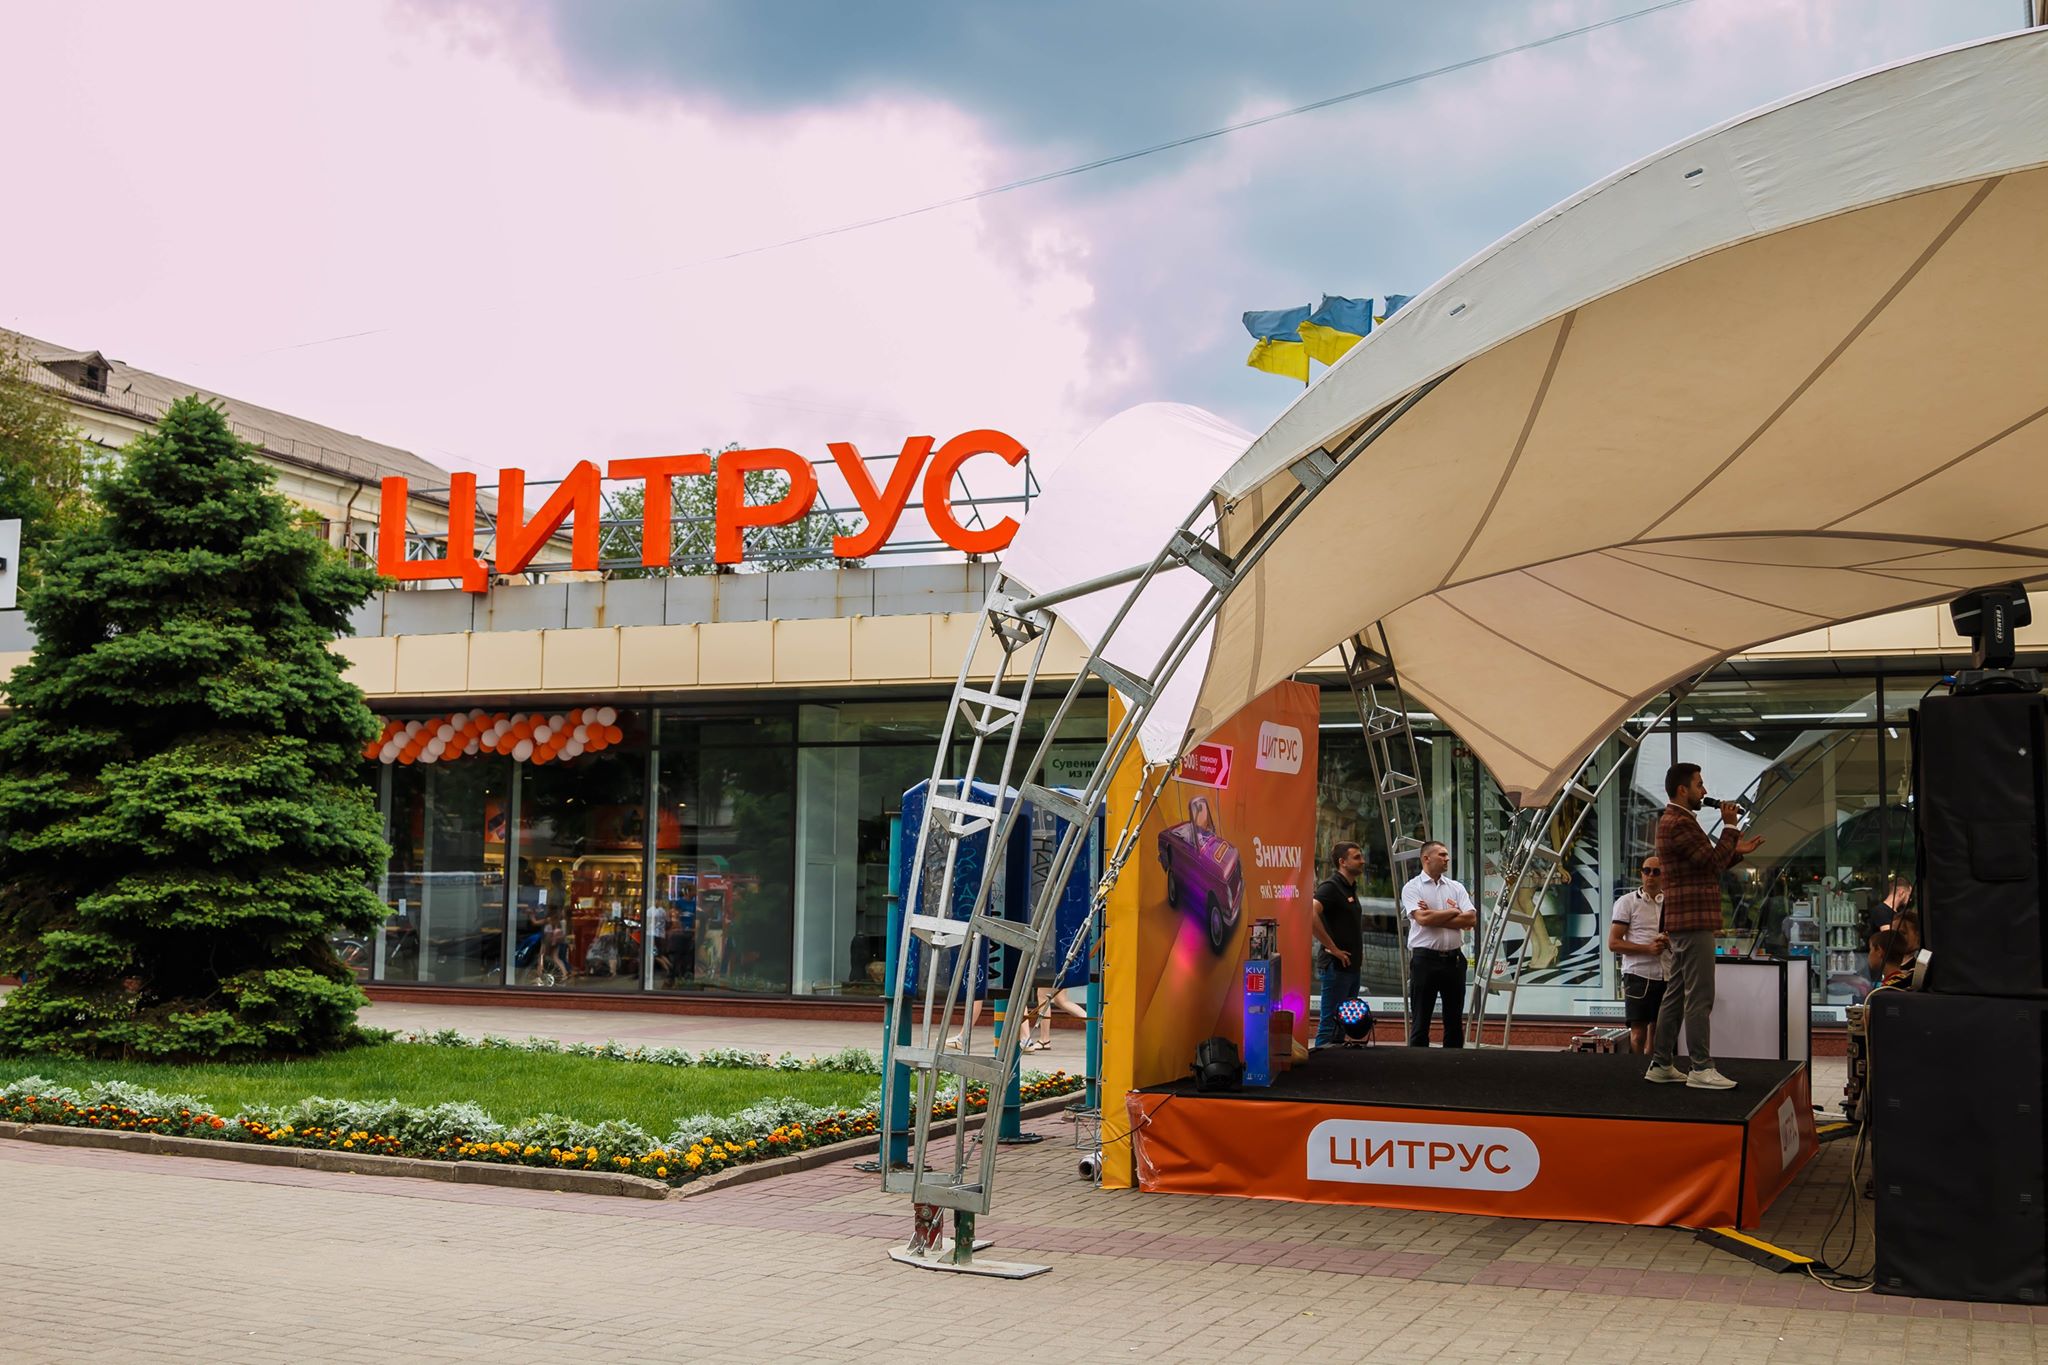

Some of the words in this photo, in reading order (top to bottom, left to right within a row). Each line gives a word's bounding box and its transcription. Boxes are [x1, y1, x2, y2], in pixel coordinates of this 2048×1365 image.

[378, 429, 1029, 593] ЦИТРУС
[1261, 734, 1297, 761] ЦИТРУС
[1329, 1136, 1511, 1174] ЦИТРУС
